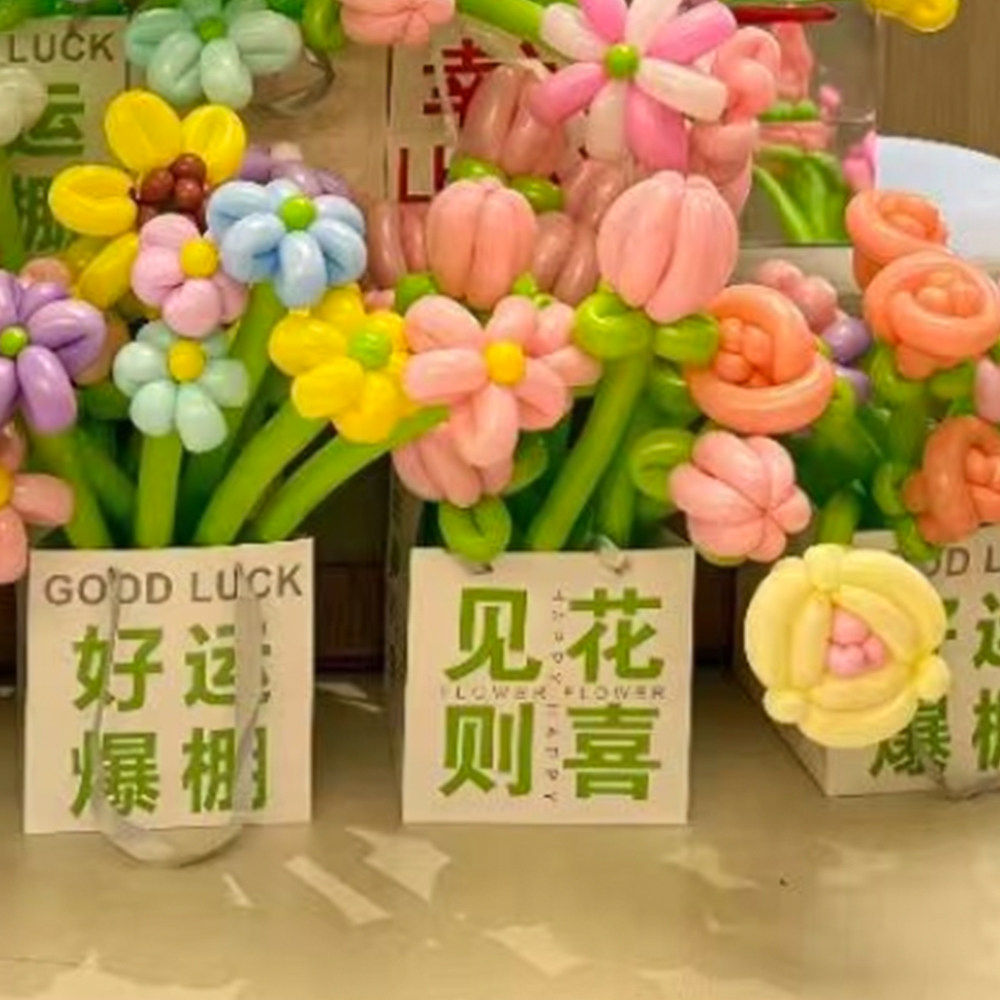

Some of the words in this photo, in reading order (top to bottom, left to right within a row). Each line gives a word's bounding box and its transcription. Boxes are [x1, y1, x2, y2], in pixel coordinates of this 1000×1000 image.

[8, 31, 115, 63] LUCK
[44, 571, 173, 606] GOOD
[190, 563, 302, 602] LUCK
[69, 726, 268, 818] 爆棚
